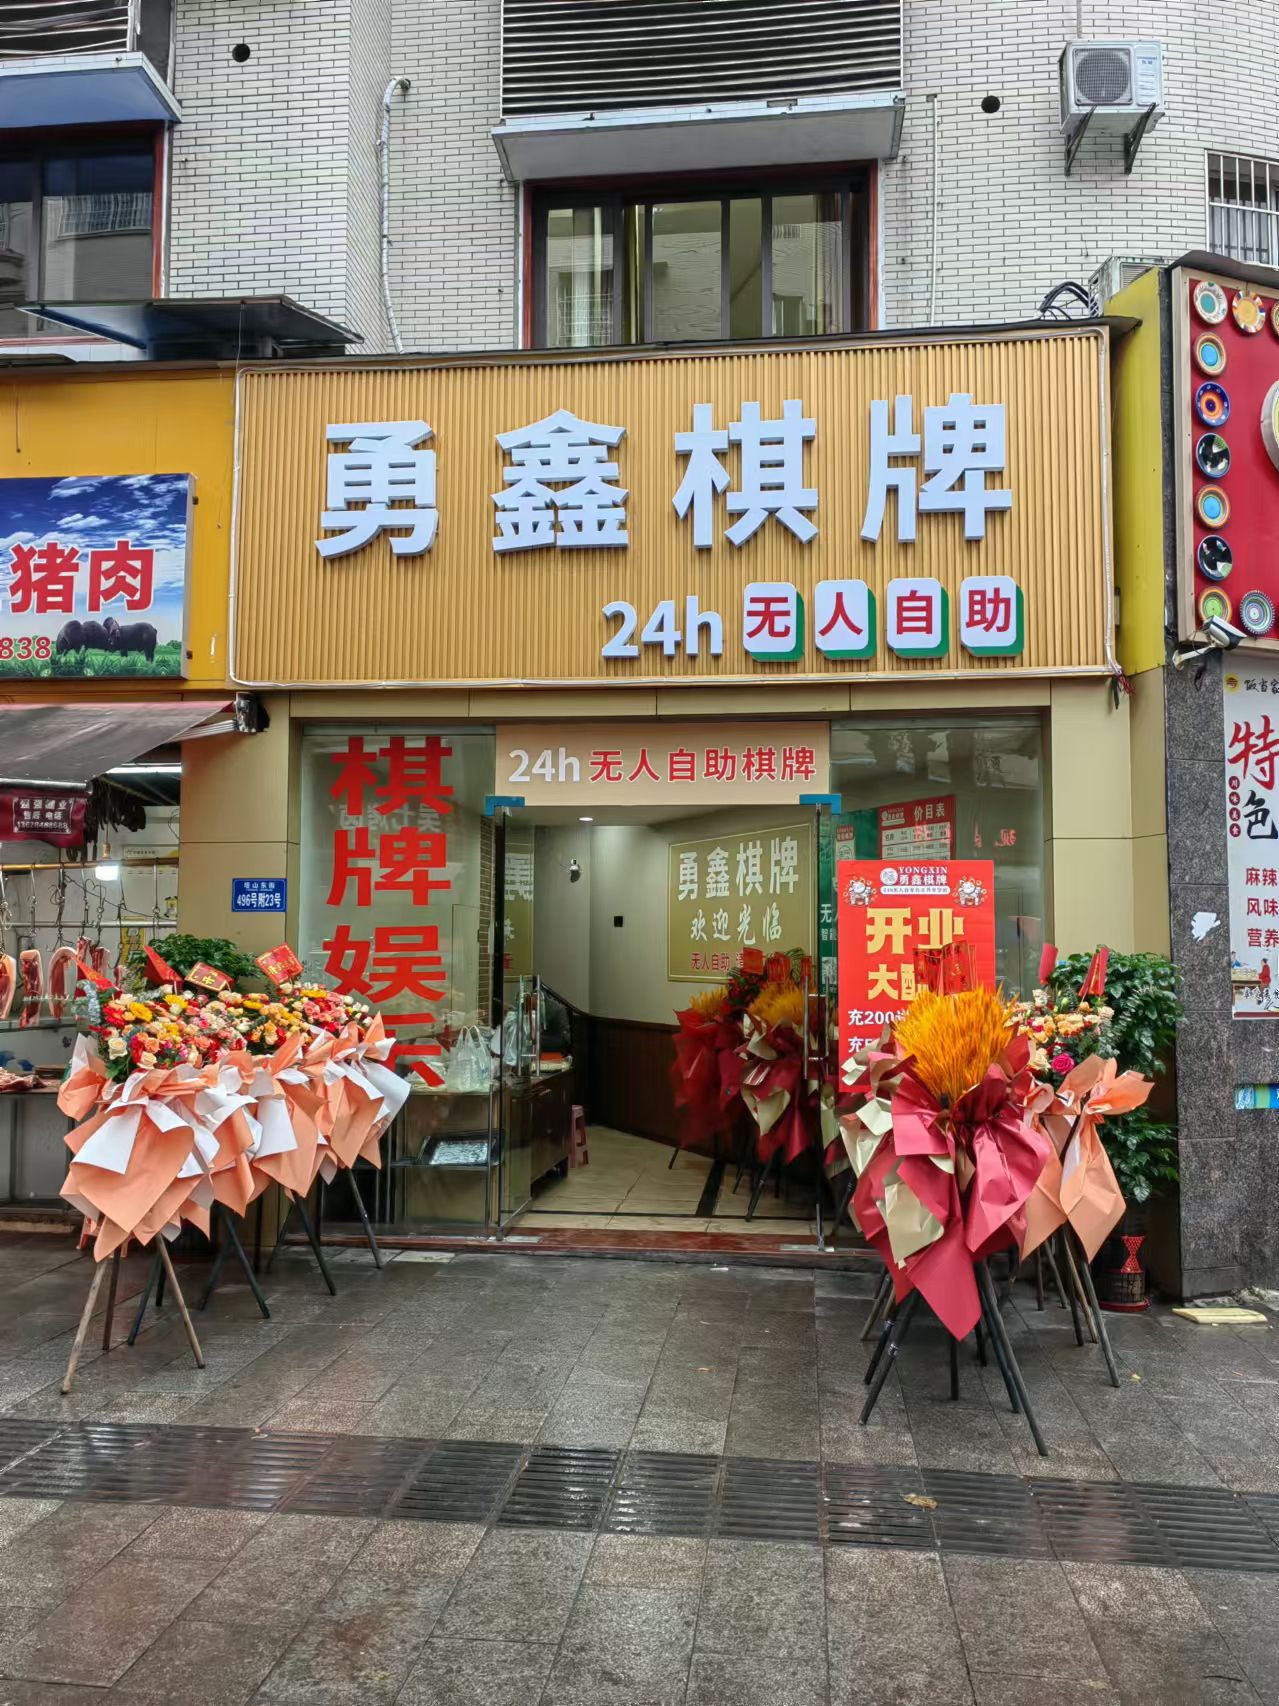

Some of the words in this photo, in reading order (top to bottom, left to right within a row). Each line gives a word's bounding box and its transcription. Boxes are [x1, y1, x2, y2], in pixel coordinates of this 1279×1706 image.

[315, 393, 1012, 559] 勇鑫棋牌
[9, 540, 155, 614] 猪肉
[601, 595, 723, 658] 24h
[744, 582, 1015, 645] 无人自助
[508, 747, 580, 783] 24h
[588, 746, 817, 783] 无人自助棋牌
[914, 803, 945, 821] 价目表
[678, 836, 799, 901] 勇鑫棋牌
[899, 866, 947, 874] YONGXIN
[1246, 867, 1279, 887] 麻辣
[900, 874, 947, 886] 勇鑫棋牌
[237, 892, 281, 908] 496号附23号
[1247, 897, 1279, 917] 风味
[691, 902, 782, 945] 欢迎光临
[820, 904, 838, 923] 无
[866, 907, 964, 955] 开业
[1248, 927, 1279, 949] 营养
[691, 952, 730, 971] 无人自助
